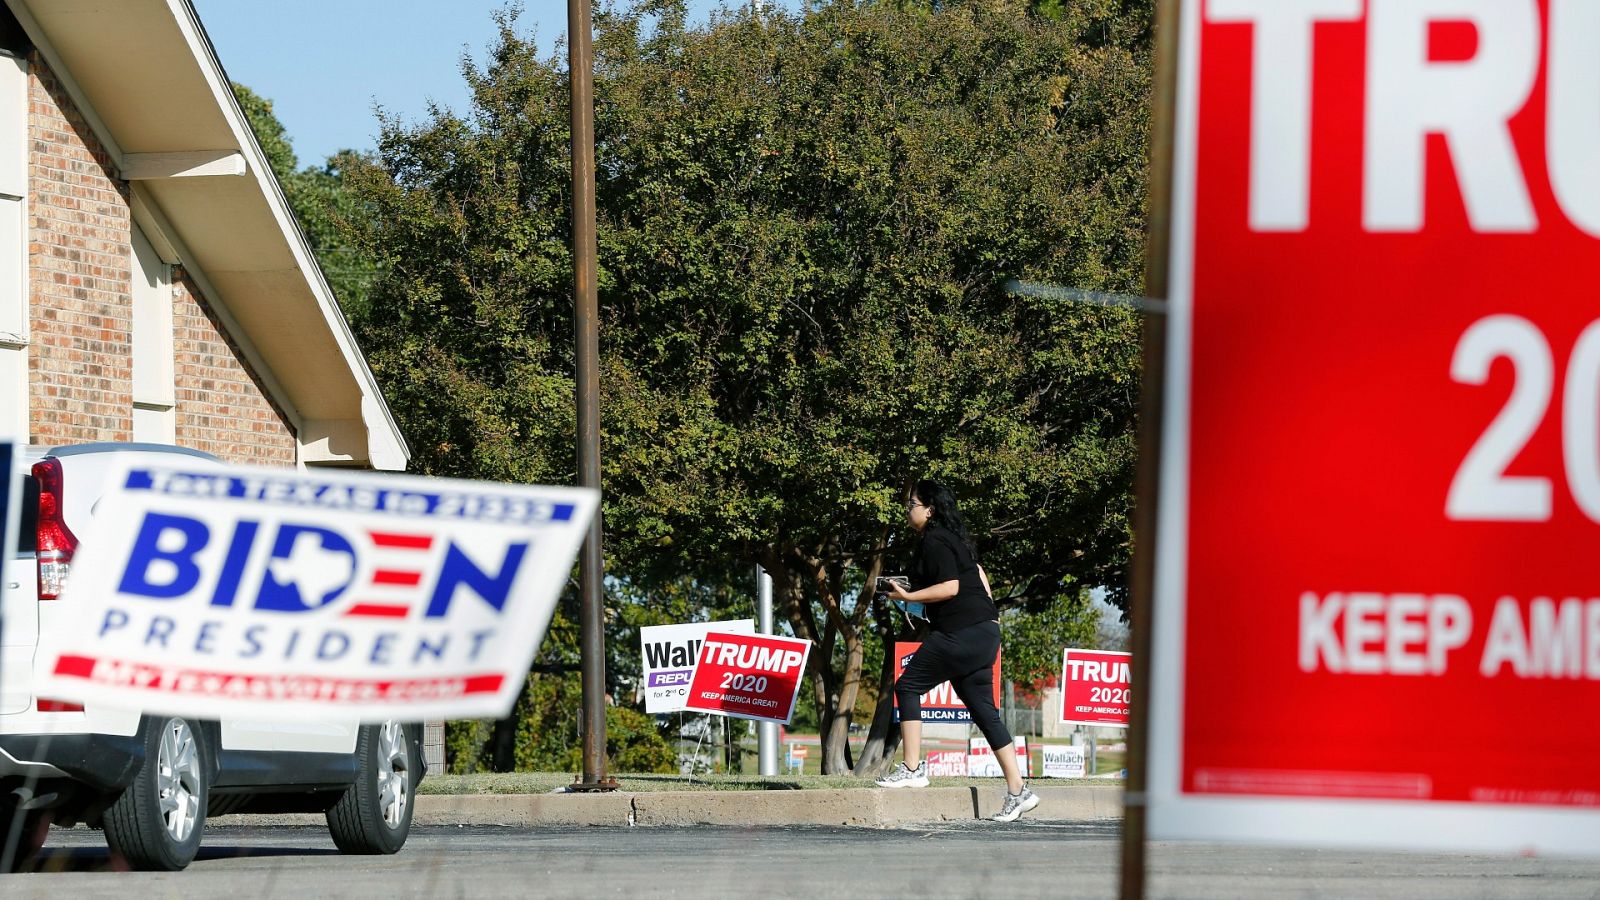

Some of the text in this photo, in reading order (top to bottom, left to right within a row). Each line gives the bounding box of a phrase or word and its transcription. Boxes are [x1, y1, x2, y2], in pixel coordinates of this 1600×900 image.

[151, 470, 556, 526] Text TEXAS to 21333
[117, 512, 530, 619] BIDEN
[97, 608, 500, 667] PRESIDENT
[1298, 590, 1473, 676] KEEP
[704, 641, 803, 674] TRUMP
[719, 672, 768, 694] 2020
[665, 688, 677, 697] 2nd
[678, 688, 687, 696] C
[701, 691, 779, 709] KEEP AMERICA GREAT!
[1089, 687, 1131, 704] 2020
[957, 711, 972, 720] SH
[1075, 705, 1092, 713] KEEP
[1093, 706, 1121, 715] AMERICA
[938, 752, 965, 764] LARRY
[1044, 752, 1083, 764] Wallach
[929, 763, 966, 776] FOWLER
